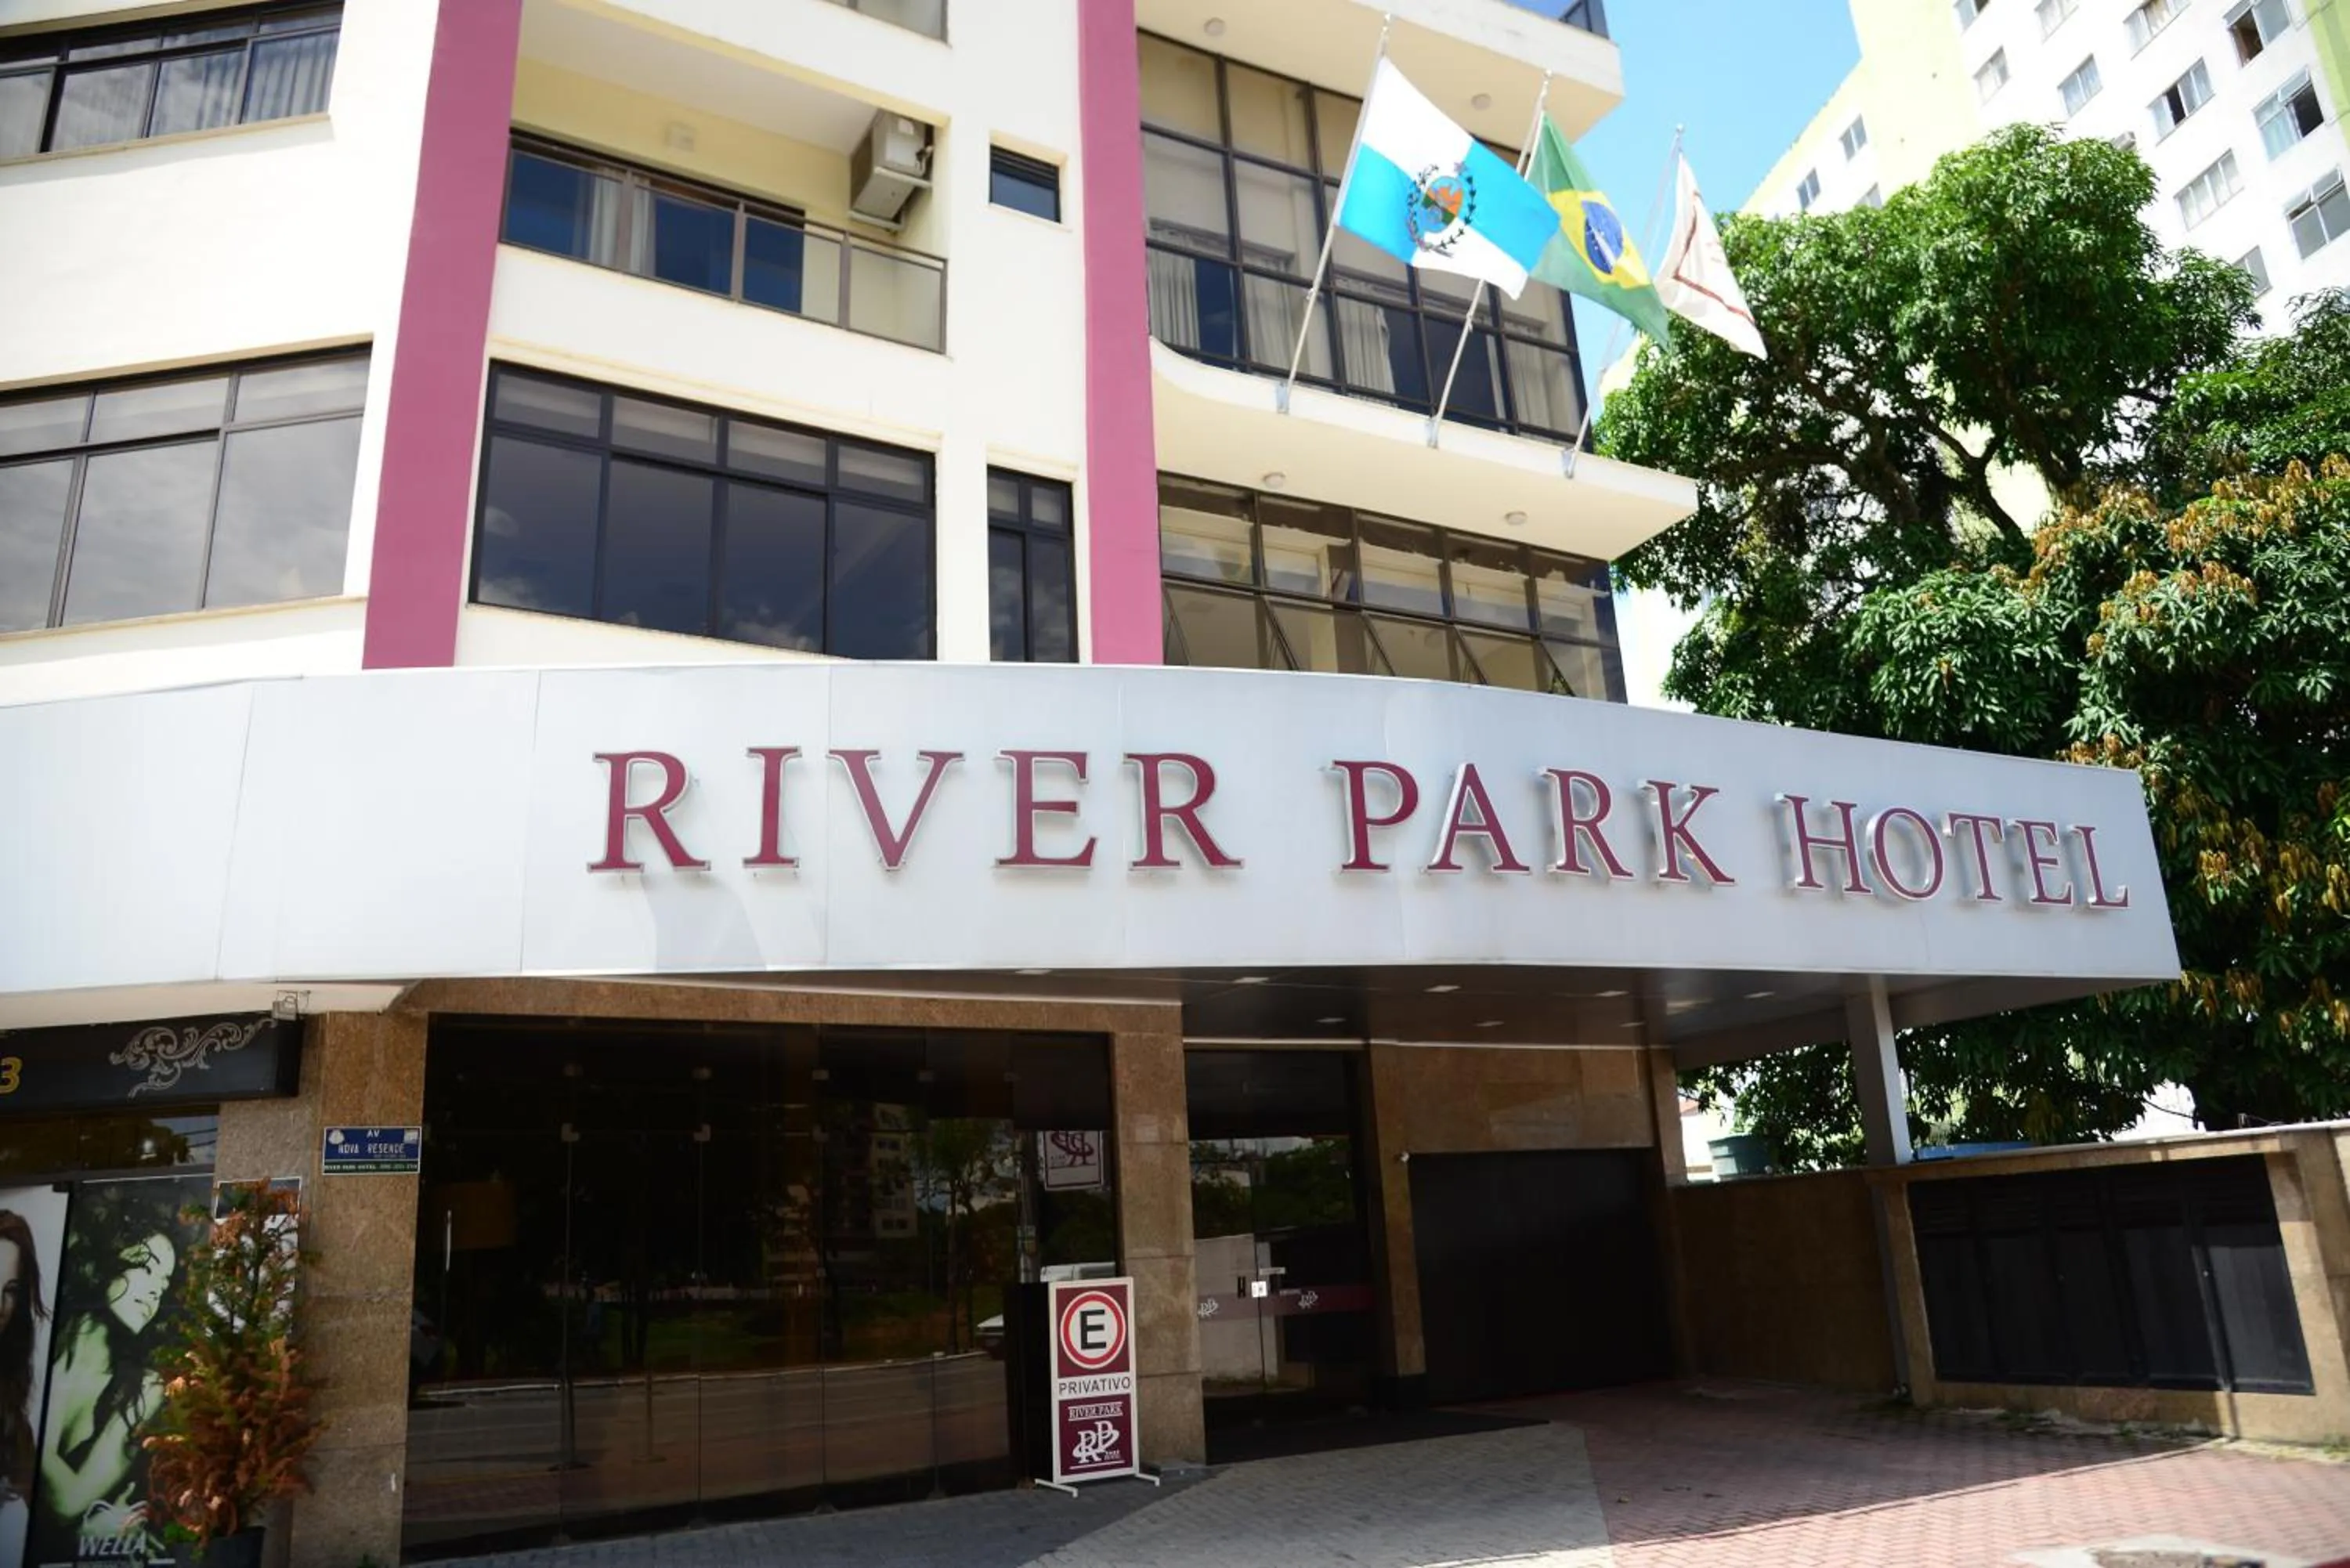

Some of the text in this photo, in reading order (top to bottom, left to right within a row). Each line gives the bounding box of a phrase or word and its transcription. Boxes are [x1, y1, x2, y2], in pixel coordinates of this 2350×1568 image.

[586, 746, 2131, 909] RIVER PARK HOTEL
[0, 1057, 23, 1095] 3
[338, 1143, 405, 1154] NOVA RESENDE
[1080, 1309, 1107, 1349] E
[1058, 1376, 1131, 1394] PRIVATIVO
[79, 1530, 147, 1556] WELLA
